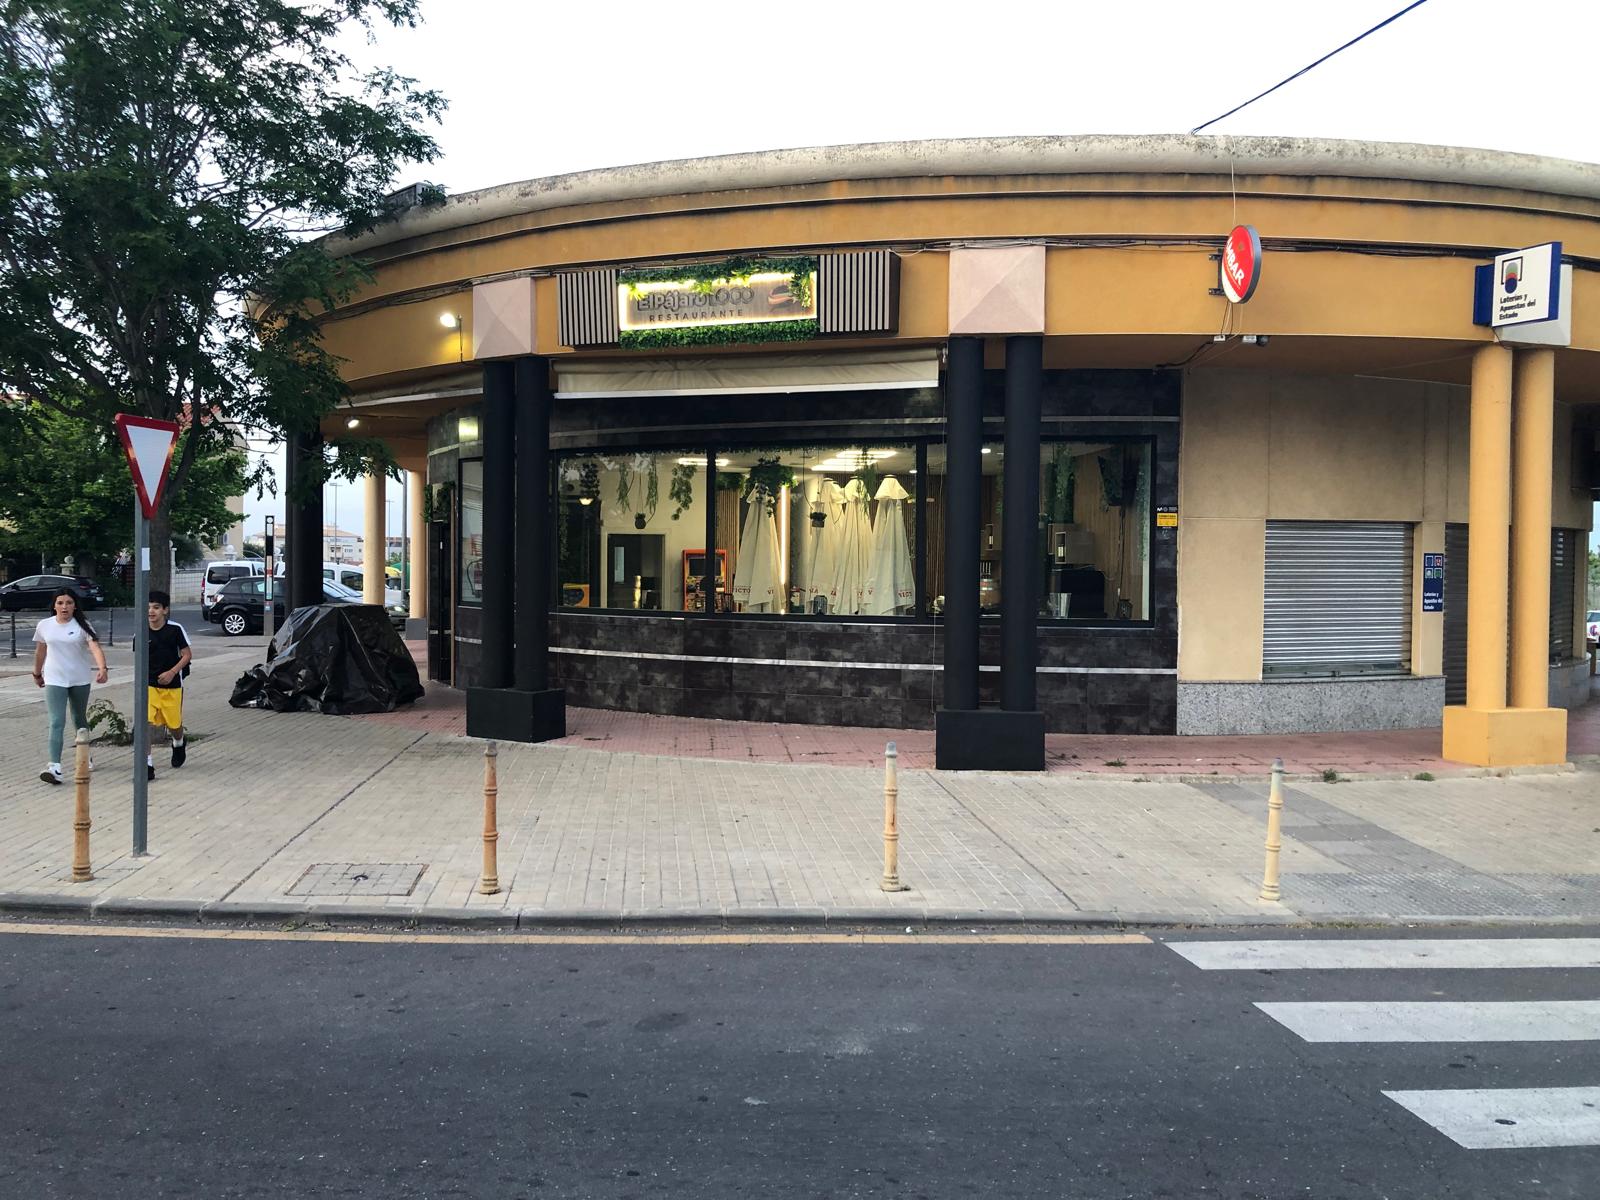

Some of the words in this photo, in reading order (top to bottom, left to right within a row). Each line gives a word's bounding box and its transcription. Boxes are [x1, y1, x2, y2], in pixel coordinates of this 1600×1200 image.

[653, 289, 708, 312] Pájaro
[1527, 299, 1536, 307] del
[649, 309, 743, 322] RESTAURANTE
[1499, 312, 1518, 320] Estado
